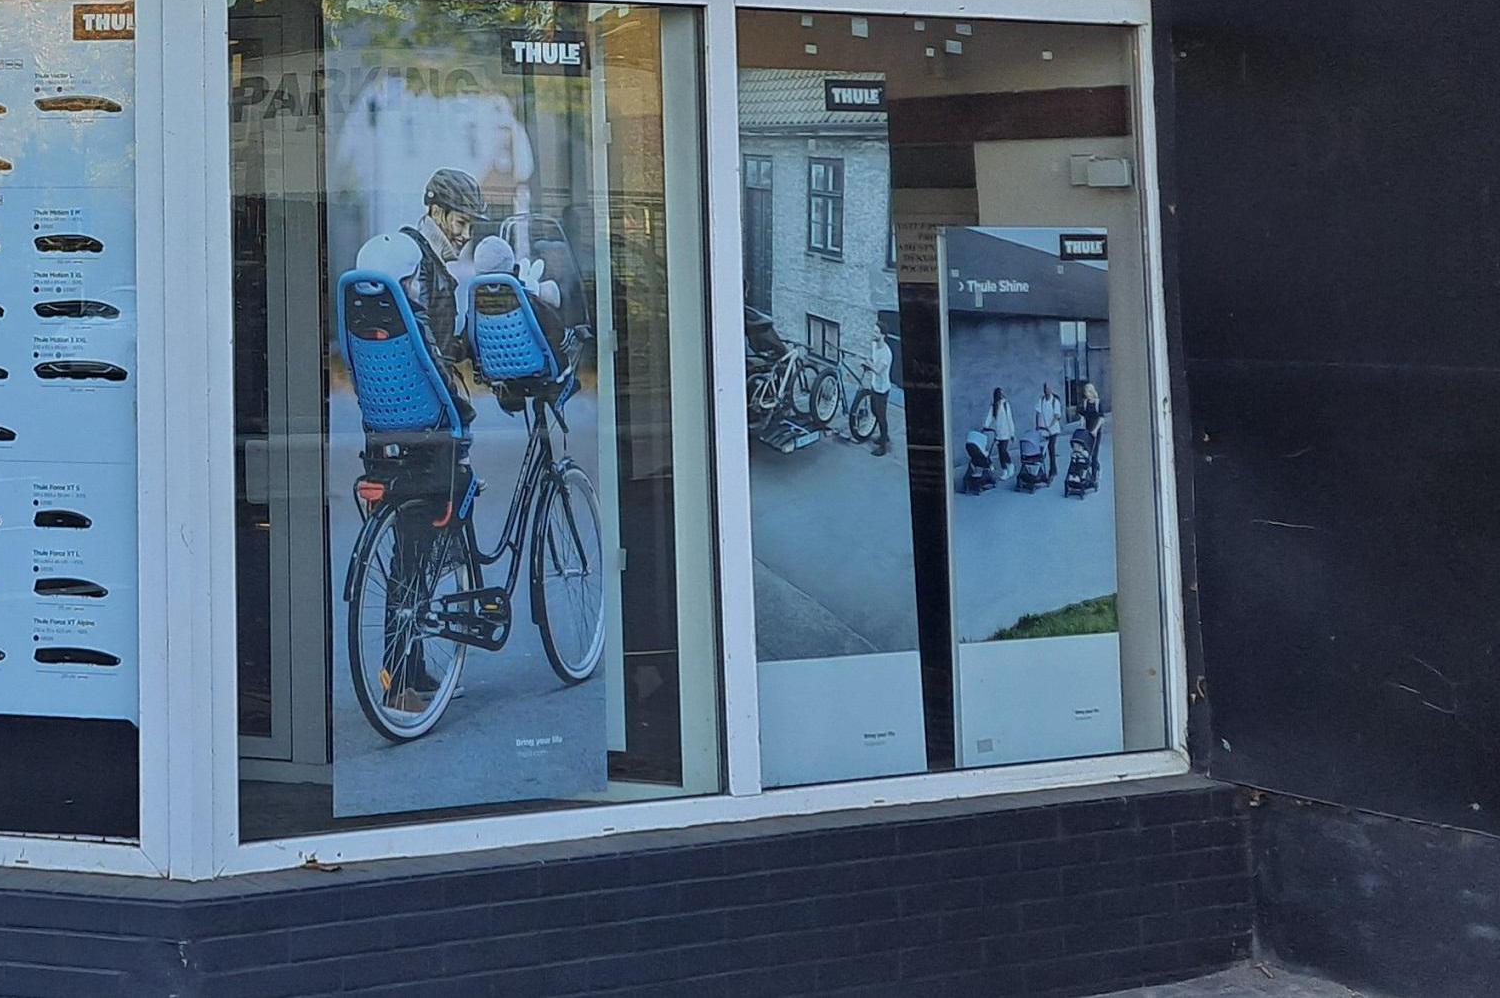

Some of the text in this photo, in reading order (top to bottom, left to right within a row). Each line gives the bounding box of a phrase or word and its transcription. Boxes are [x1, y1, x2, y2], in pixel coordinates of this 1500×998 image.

[511, 41, 581, 65] THULE
[831, 87, 879, 104] THULE
[1064, 239, 1103, 254] THULE
[967, 280, 1029, 293] Thule Shine
